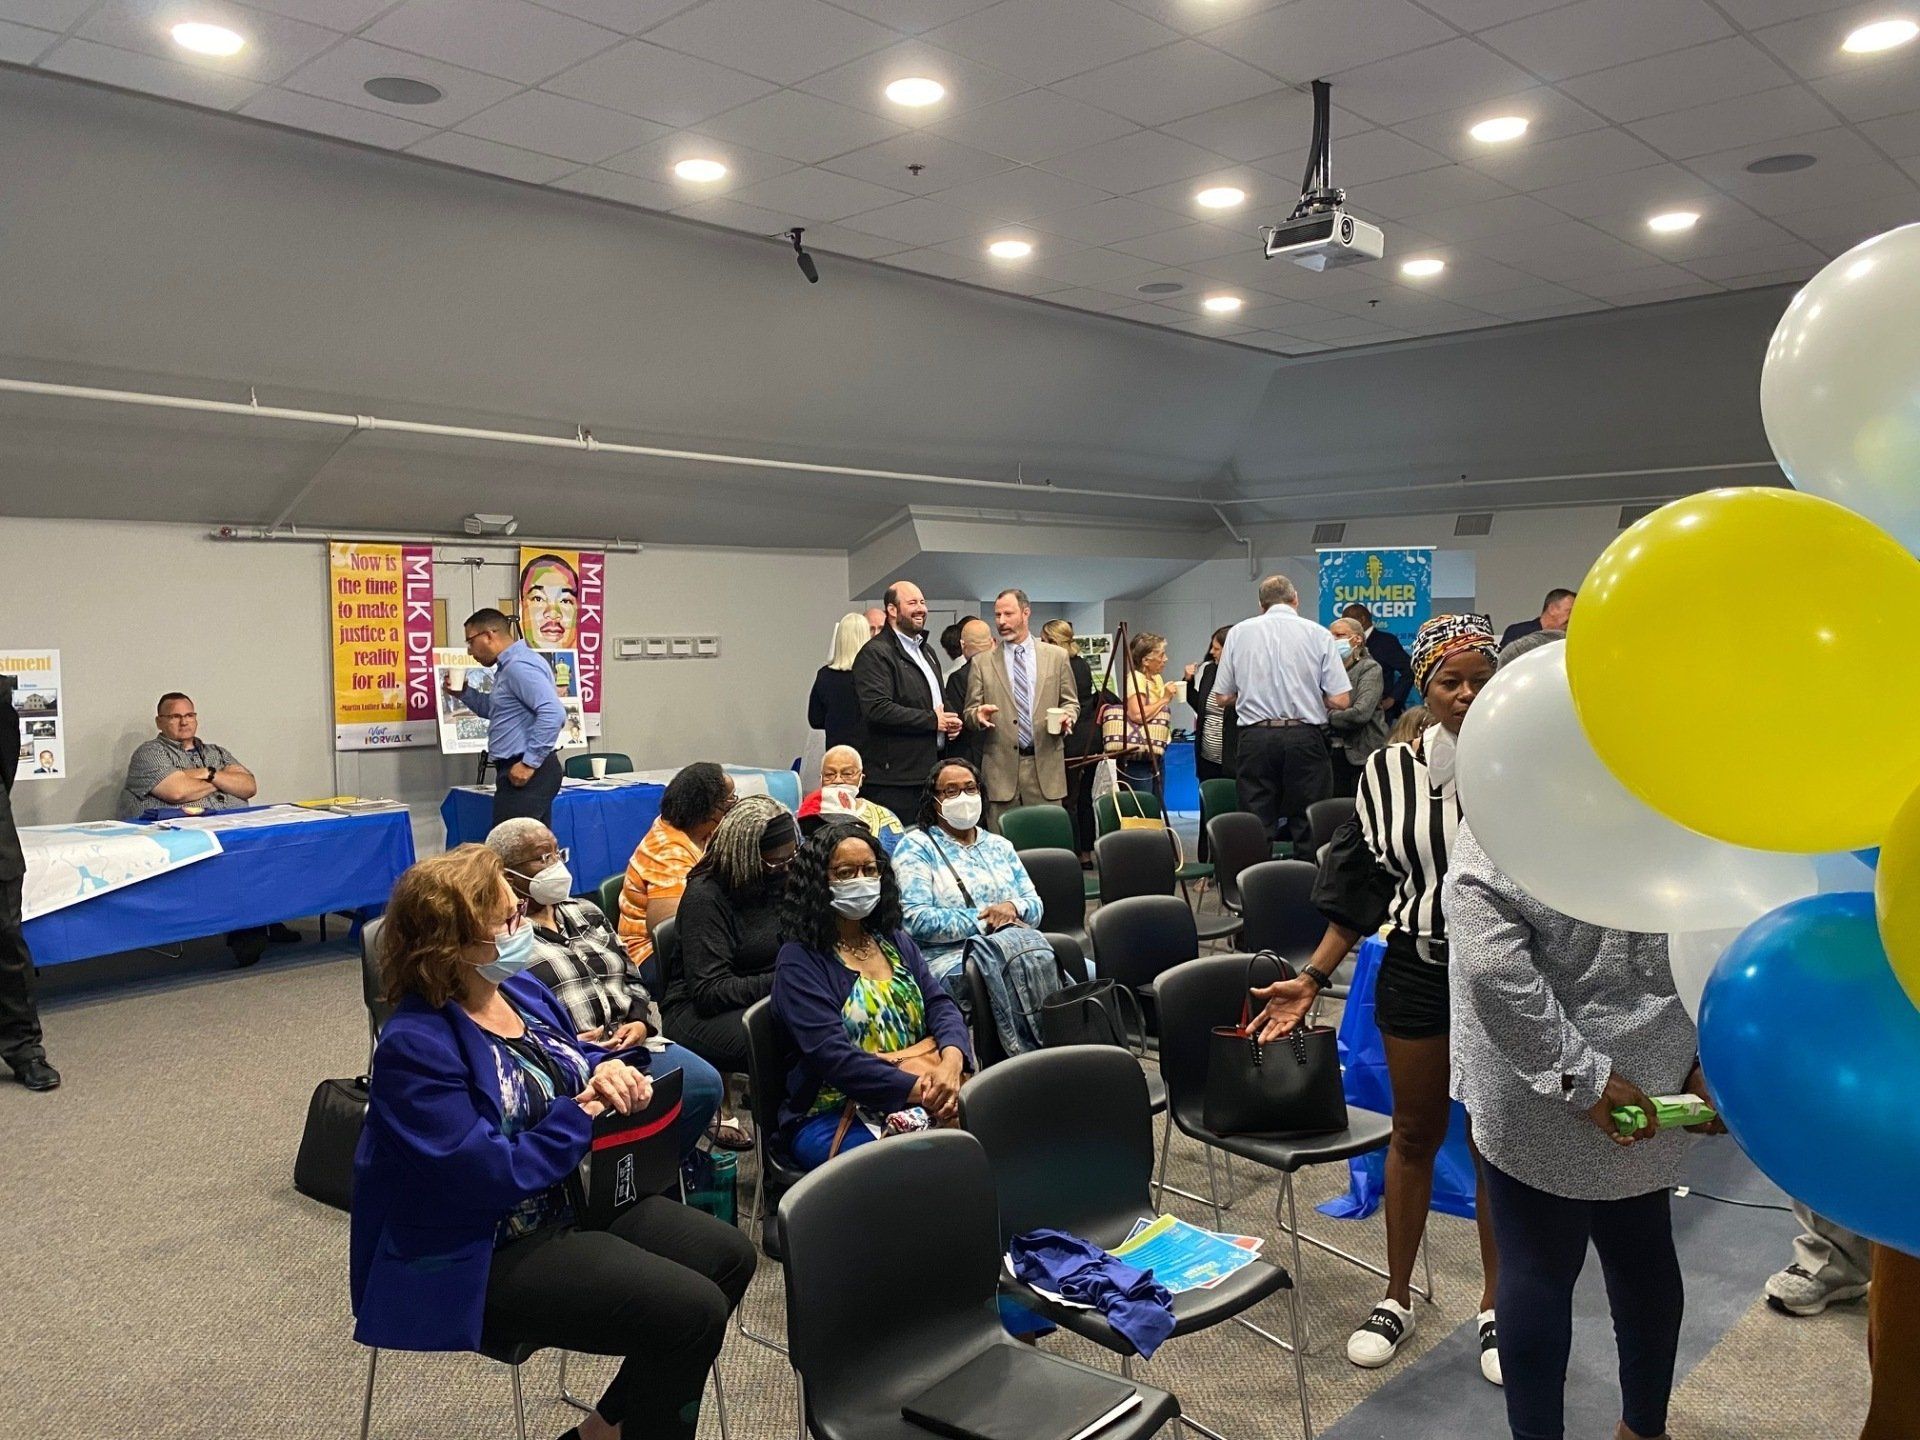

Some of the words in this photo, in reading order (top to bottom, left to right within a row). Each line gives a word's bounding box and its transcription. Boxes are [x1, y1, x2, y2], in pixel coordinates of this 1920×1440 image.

[351, 553, 381, 571] Now
[386, 553, 397, 571] is
[1355, 569, 1365, 578] 20
[1384, 569, 1394, 578] 22
[338, 577, 361, 595] the
[365, 577, 398, 595] time
[406, 555, 431, 622] MLK
[580, 562, 603, 623] MLK
[1334, 585, 1415, 601] SUMMER
[338, 602, 353, 618] to
[357, 601, 398, 619] make
[1332, 601, 1417, 618] CCERT
[339, 625, 386, 645] justice
[389, 629, 399, 642] a
[354, 648, 399, 668] reality
[408, 632, 433, 710] Drive
[580, 632, 600, 703] Drive
[352, 672, 374, 690] for
[377, 672, 400, 690] all.
[365, 734, 412, 745] NORWALK
